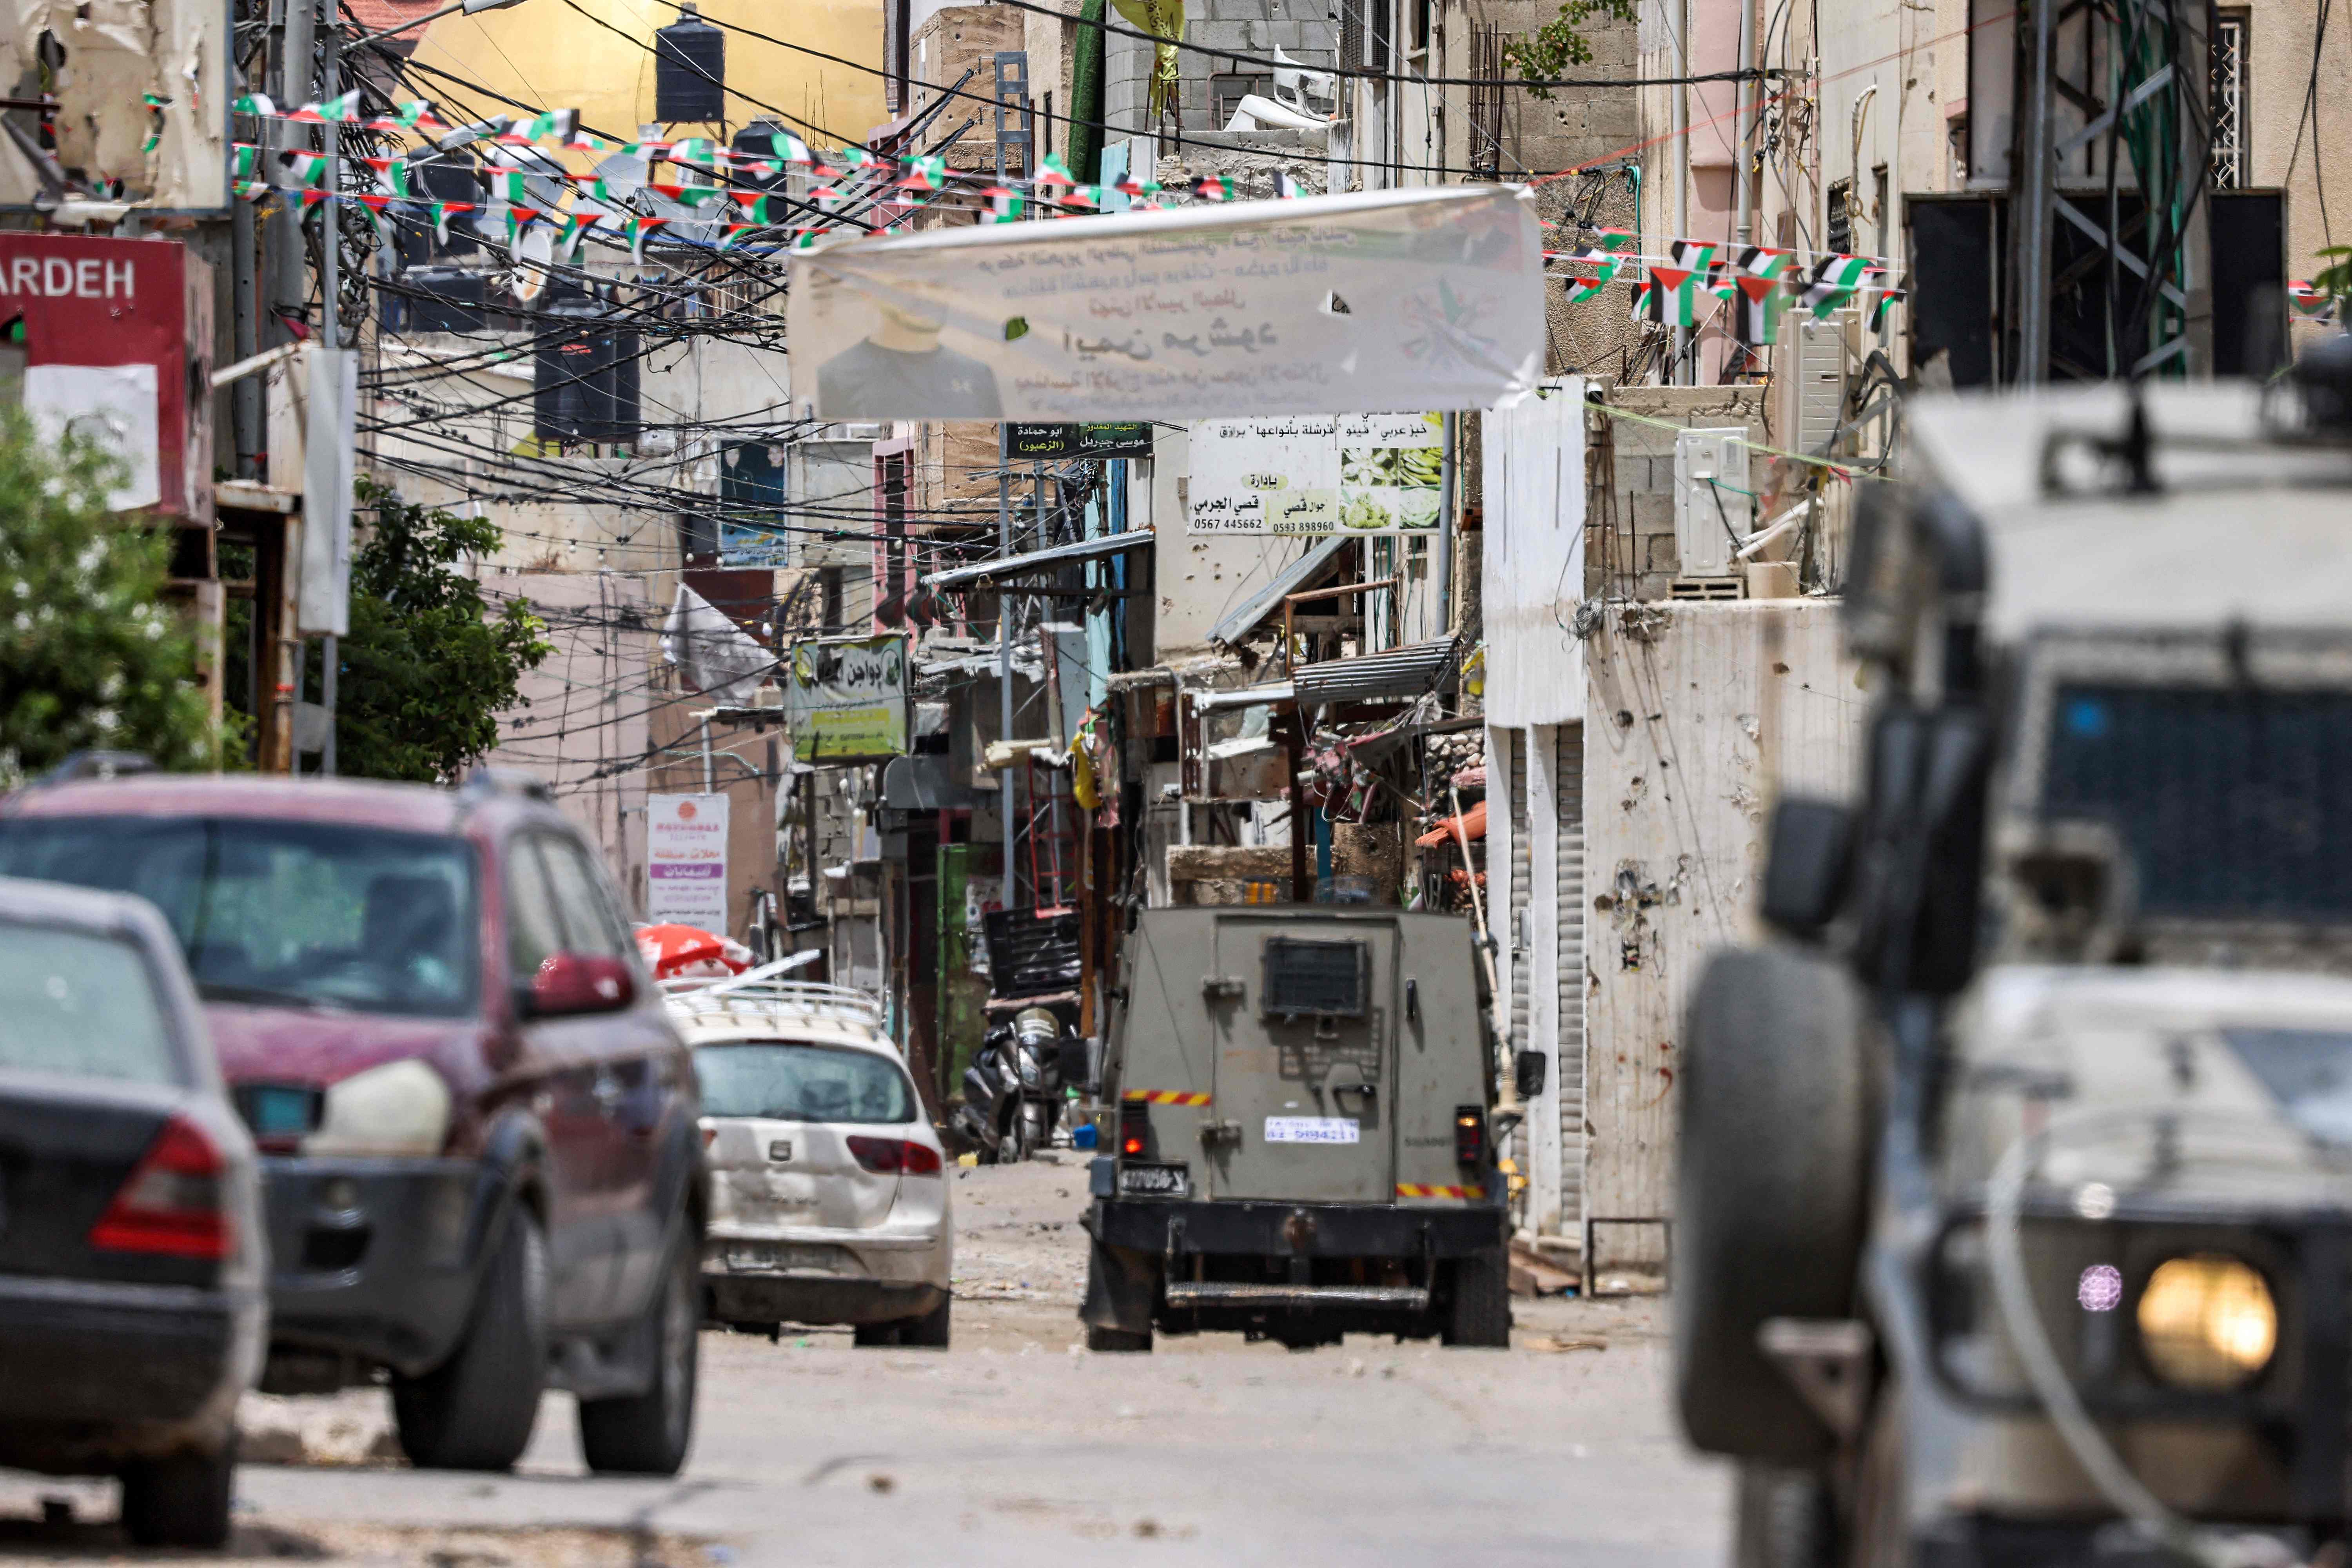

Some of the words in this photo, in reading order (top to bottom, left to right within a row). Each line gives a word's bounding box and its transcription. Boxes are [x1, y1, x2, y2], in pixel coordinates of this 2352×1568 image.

[1017, 426, 1047, 436] حمادة
[1114, 423, 1137, 432] الشهيد
[1257, 420, 1298, 437] بأنواعها
[1302, 423, 1334, 437] قرشلة
[1347, 424, 1369, 437] فينو
[1381, 427, 1406, 441] عربي
[1408, 423, 1427, 437] خبز
[1080, 436, 1114, 448] جبريل
[1116, 438, 1145, 447] موسى
[1250, 474, 1278, 490] بإدارة
[1194, 495, 1232, 515] الجرمي
[1234, 494, 1259, 516] قصي
[1283, 498, 1308, 519] قصي
[1308, 501, 1325, 513] جوال
[1194, 519, 1220, 529] 0567
[1224, 519, 1261, 529] 445662
[1274, 523, 1295, 532] 0593
[1299, 521, 1334, 532] 898960
[847, 660, 882, 687] دواجن
